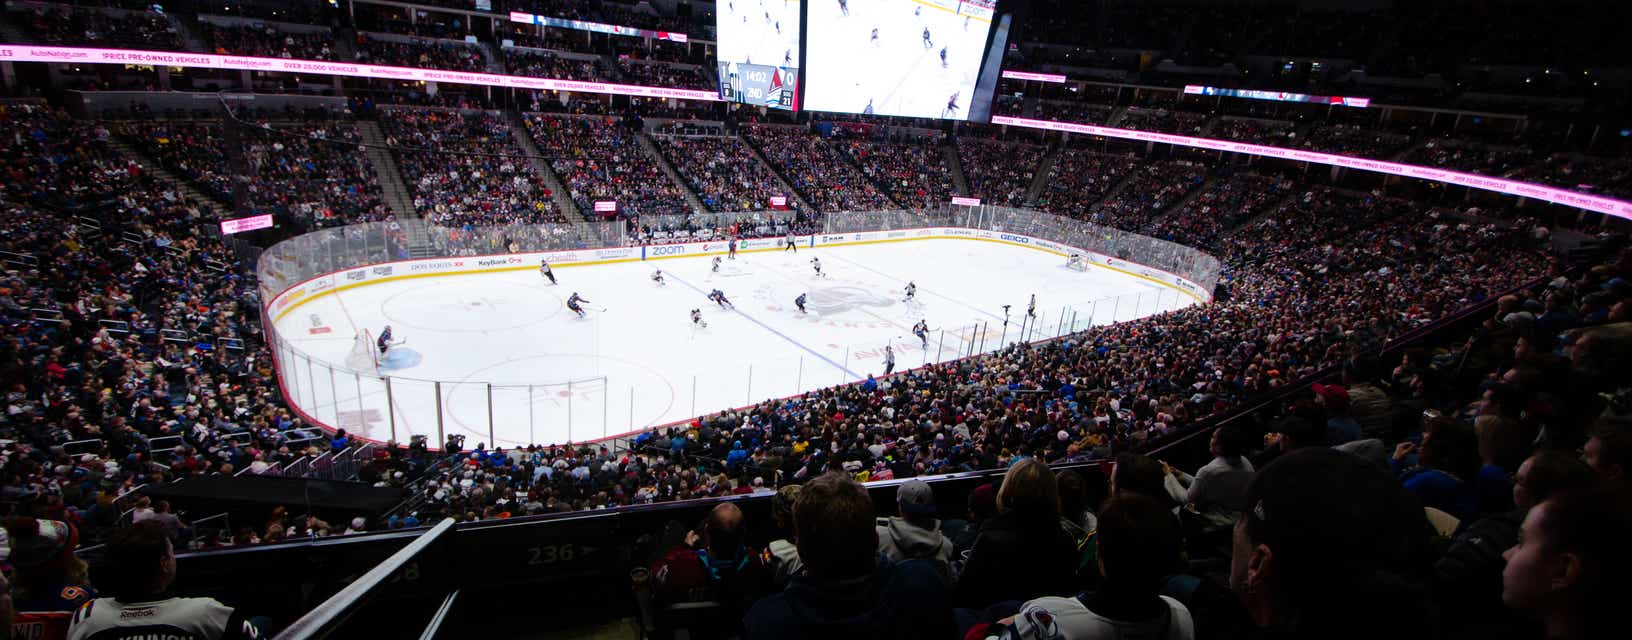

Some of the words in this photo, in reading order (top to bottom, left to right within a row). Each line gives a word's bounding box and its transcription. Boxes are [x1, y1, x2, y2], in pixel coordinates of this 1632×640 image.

[30, 50, 89, 60] AutoNation.com
[128, 53, 173, 63] PRE-OWNED
[175, 56, 211, 65] VEHICLES
[223, 58, 272, 68] AutoNation.com
[283, 62, 301, 70] OVER
[327, 65, 359, 74] VEHICLES
[745, 71, 768, 82] 14:02
[786, 73, 795, 87] 0
[746, 88, 763, 99] 2ND
[783, 98, 792, 107] 21
[1000, 233, 1030, 244] GEICO
[652, 246, 685, 256] zoom
[478, 258, 507, 268] KeyBank
[527, 543, 574, 565] 236
[120, 608, 155, 619] Reebok
